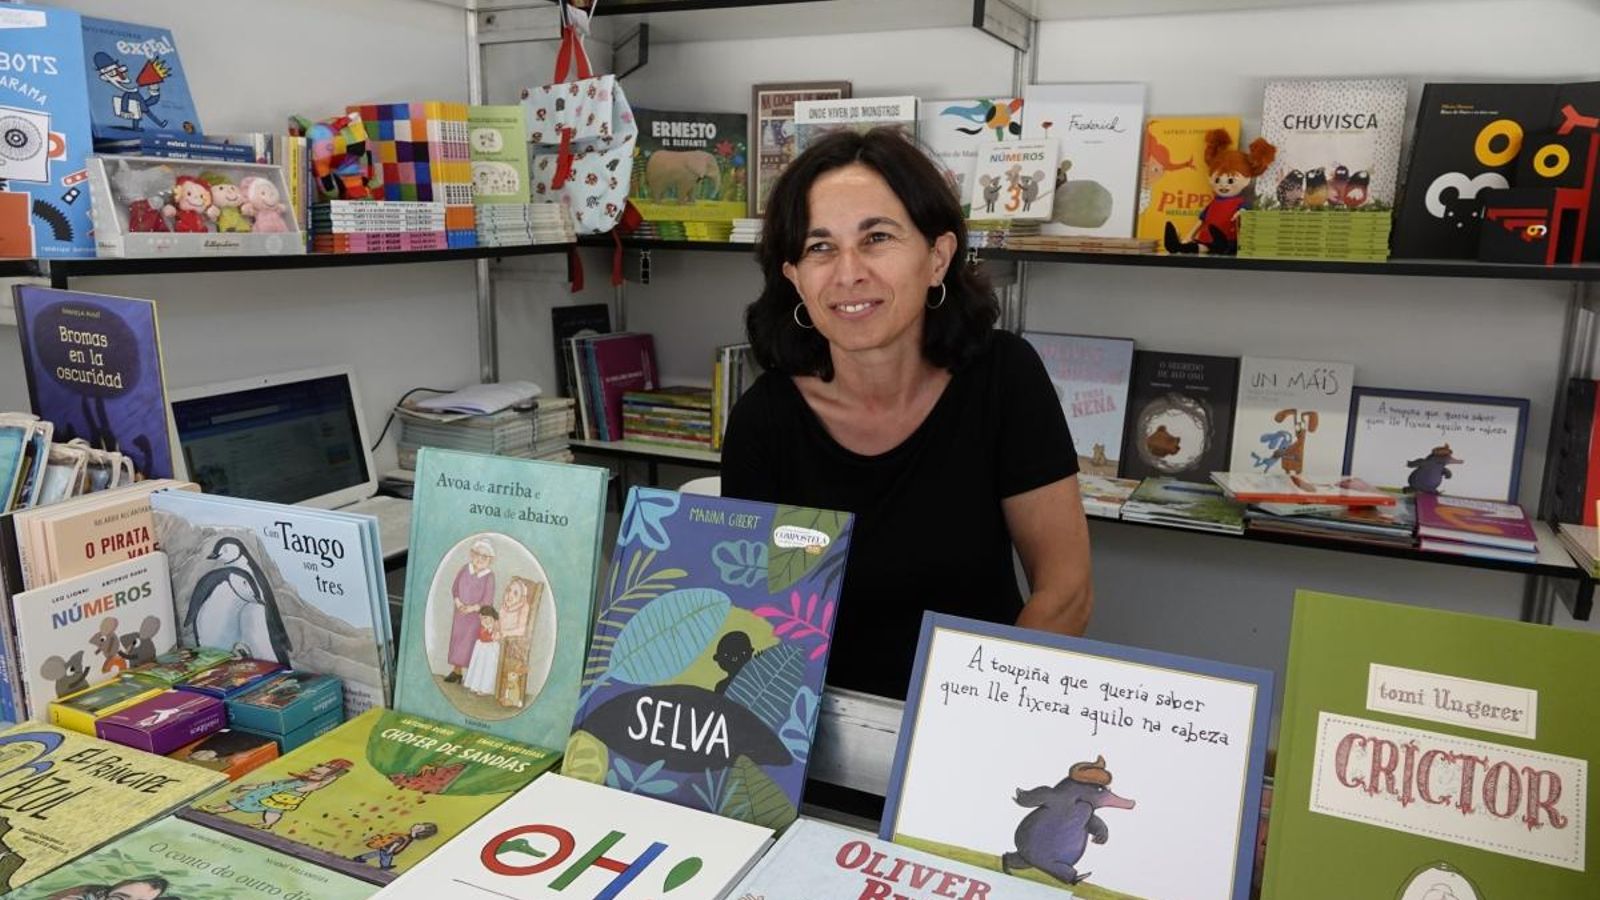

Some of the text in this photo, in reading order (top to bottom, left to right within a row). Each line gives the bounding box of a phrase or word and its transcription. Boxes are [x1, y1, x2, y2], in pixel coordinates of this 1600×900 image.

[861, 104, 900, 117] MONSTROS
[1283, 113, 1378, 130] CHUVISCA
[652, 120, 716, 139] ERNESTO
[1068, 114, 1127, 134] Frederick
[990, 152, 1045, 162] NÚMEROS
[58, 326, 108, 348] Bromas
[69, 348, 104, 366] en la
[56, 366, 124, 389] oscuridad
[1252, 372, 1276, 388] UN
[436, 472, 470, 490] Avoa
[472, 482, 486, 492] de
[487, 482, 532, 498] arriba
[470, 502, 568, 527] avoa de abaixo
[689, 506, 762, 530] MARINA GIBERT
[86, 526, 150, 559] O PIRATA
[274, 521, 345, 569] Tango
[303, 562, 318, 572] son
[316, 576, 344, 596] tres
[52, 581, 152, 630] NÚMEROS
[968, 644, 1206, 713] A toupiña que quería saber
[940, 680, 1230, 746] quen lle fixera aquilo na cabeza
[1380, 682, 1523, 724] tomi Ungerer
[628, 696, 730, 760] SELVA
[381, 728, 532, 773] CHOFER DE SANDÍAS
[148, 842, 313, 900] O conto do outro dí
[835, 840, 992, 900] OLIVER
